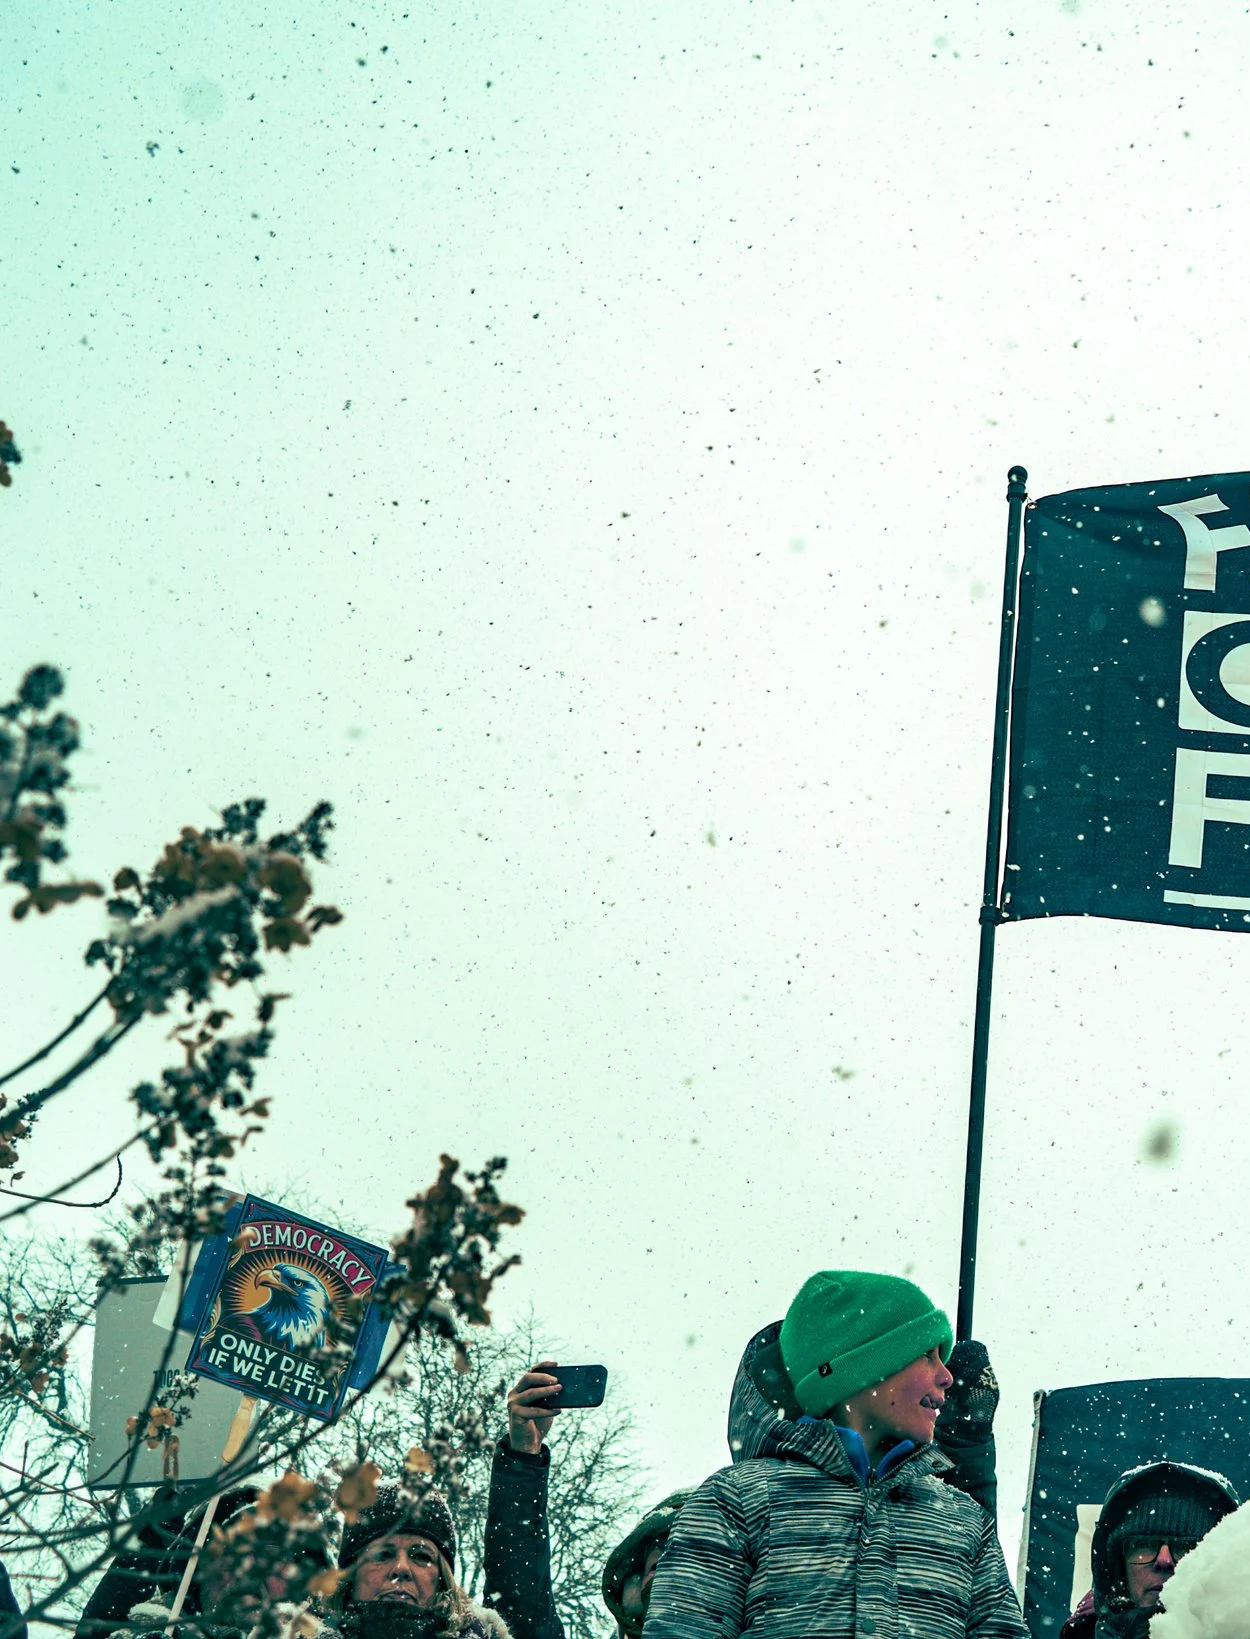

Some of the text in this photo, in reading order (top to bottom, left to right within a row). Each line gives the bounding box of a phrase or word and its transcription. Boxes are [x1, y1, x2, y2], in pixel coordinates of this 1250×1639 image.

[245, 1224, 371, 1286] DEMOCRACY
[208, 1348, 230, 1366] IF
[233, 1356, 265, 1382] WE
[267, 1371, 306, 1397] LET
[220, 1334, 325, 1386] ONLY DIES
